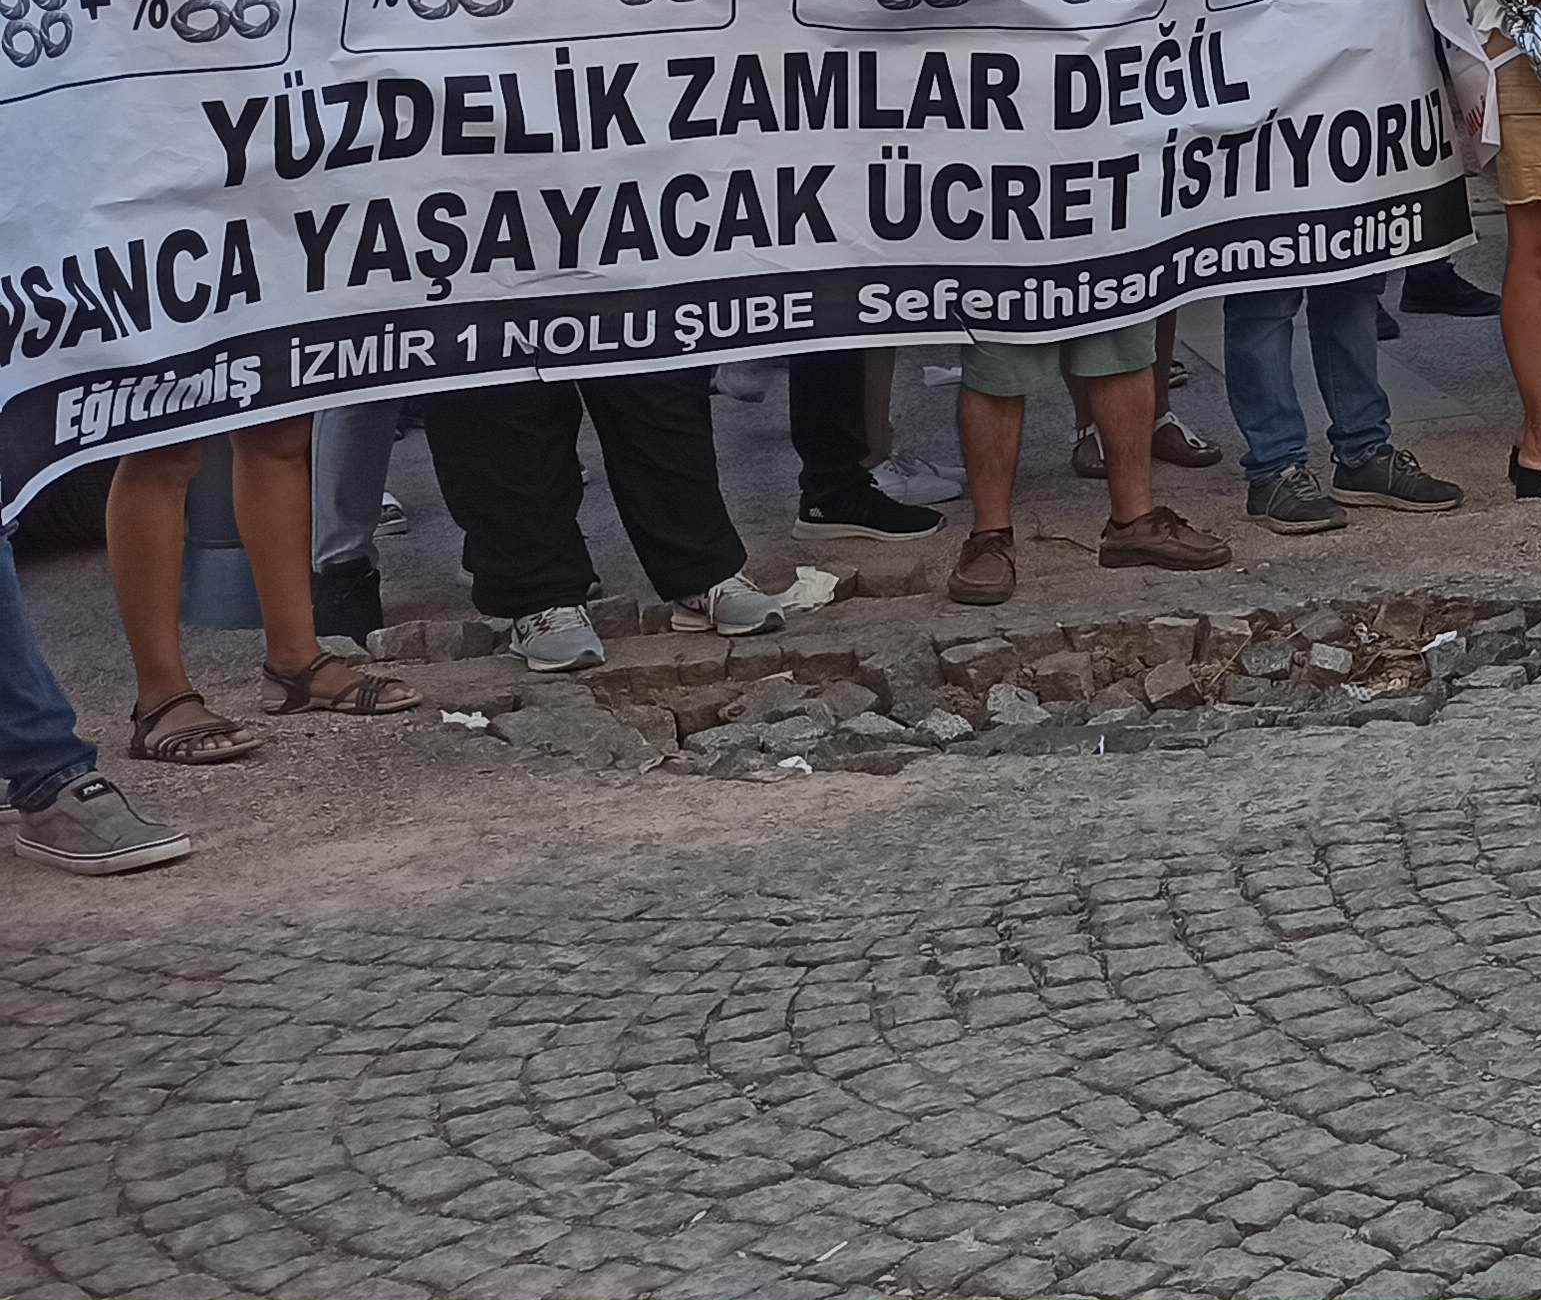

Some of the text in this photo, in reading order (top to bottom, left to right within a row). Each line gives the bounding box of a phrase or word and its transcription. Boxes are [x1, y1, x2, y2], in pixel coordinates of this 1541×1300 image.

[201, 17, 1251, 188] YÜZDELİK ZAMLAR DEĞİL
[293, 163, 838, 301] YAŞAYACAK
[867, 146, 1141, 244] ÜCRET
[1160, 87, 1454, 219] İSTİYORUZ
[54, 203, 1424, 446] Eğitimiş İZMİR 1 NOLU ŞUBE Seferihisar Temsilciliği
